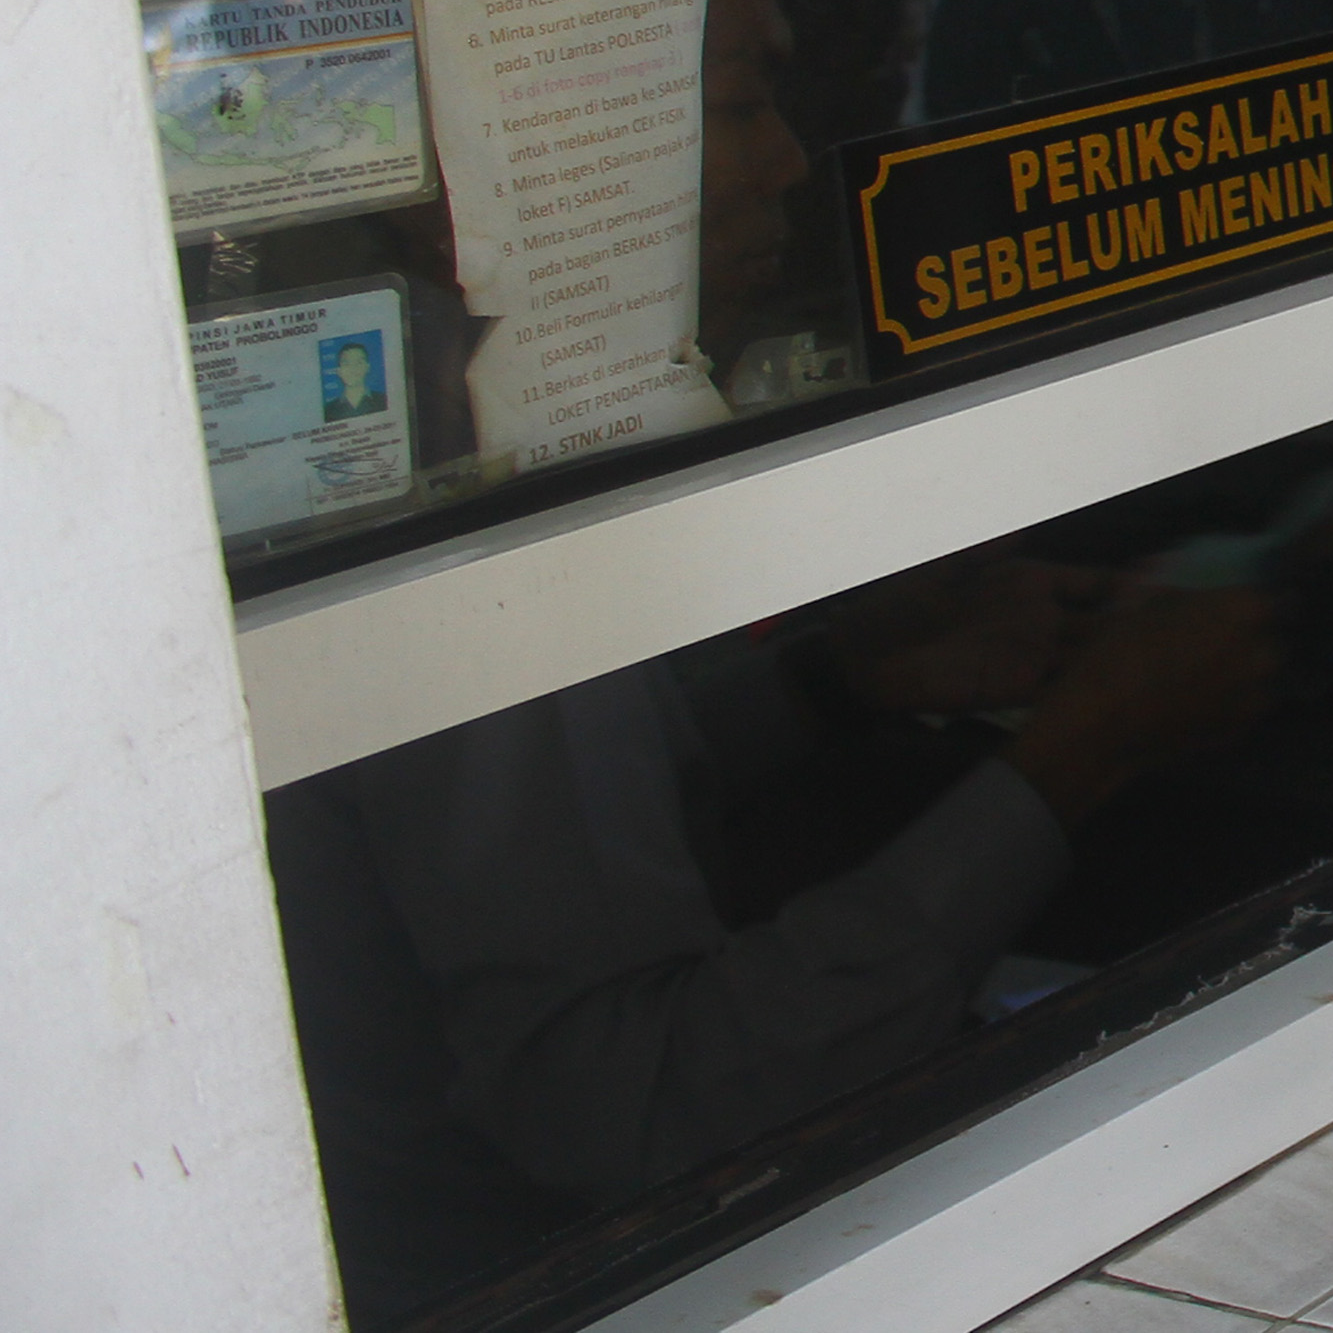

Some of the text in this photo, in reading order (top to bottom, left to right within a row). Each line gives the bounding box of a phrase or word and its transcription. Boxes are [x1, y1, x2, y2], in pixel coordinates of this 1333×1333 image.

[184, 8, 405, 52] REPUBLIK INDONESIA
[251, 3, 307, 21] TANDA
[489, 25, 535, 45] Minta
[538, 16, 577, 36] surat
[579, 1, 656, 26] keterangan
[494, 55, 532, 77] pada
[534, 47, 556, 66] TU
[559, 37, 604, 61] Lantas
[607, 22, 673, 50] POLRESTA
[481, 122, 498, 139] 7.
[502, 106, 582, 134] Kendaraan
[584, 100, 600, 116] di
[602, 93, 639, 112] bawa
[640, 87, 656, 103] ke
[507, 141, 551, 164] untuk
[553, 124, 629, 153] melakukan
[631, 116, 657, 134] CEK
[511, 171, 557, 193] Minta
[559, 162, 597, 183] leges
[598, 150, 651, 176] (Salinan
[517, 200, 556, 223] loket
[573, 179, 635, 208] SAMSAT.
[522, 230, 566, 252] Minta
[568, 221, 604, 241] surat
[606, 198, 677, 233] pernyataan
[528, 262, 563, 285] pada
[565, 247, 611, 271] bagian
[612, 230, 663, 259] BERKAS
[914, 206, 1169, 322] SEBELUM
[543, 274, 611, 309] (SAMSAT)
[233, 317, 276, 334] JAWA
[281, 308, 328, 326] TIMUR
[235, 322, 319, 347] PROBOLINGGO
[514, 326, 537, 345] 10.
[537, 317, 563, 339] Beli
[566, 301, 623, 329] Formulir
[540, 333, 608, 370] (SAMSAT)
[522, 388, 545, 405] 11.
[545, 372, 590, 397] Berkas
[592, 366, 606, 382] di
[607, 348, 667, 377] serahkan
[548, 397, 592, 426] LOKET
[594, 366, 689, 411] PENDAFTARAN
[529, 413, 644, 466] 12. STNK JADI
